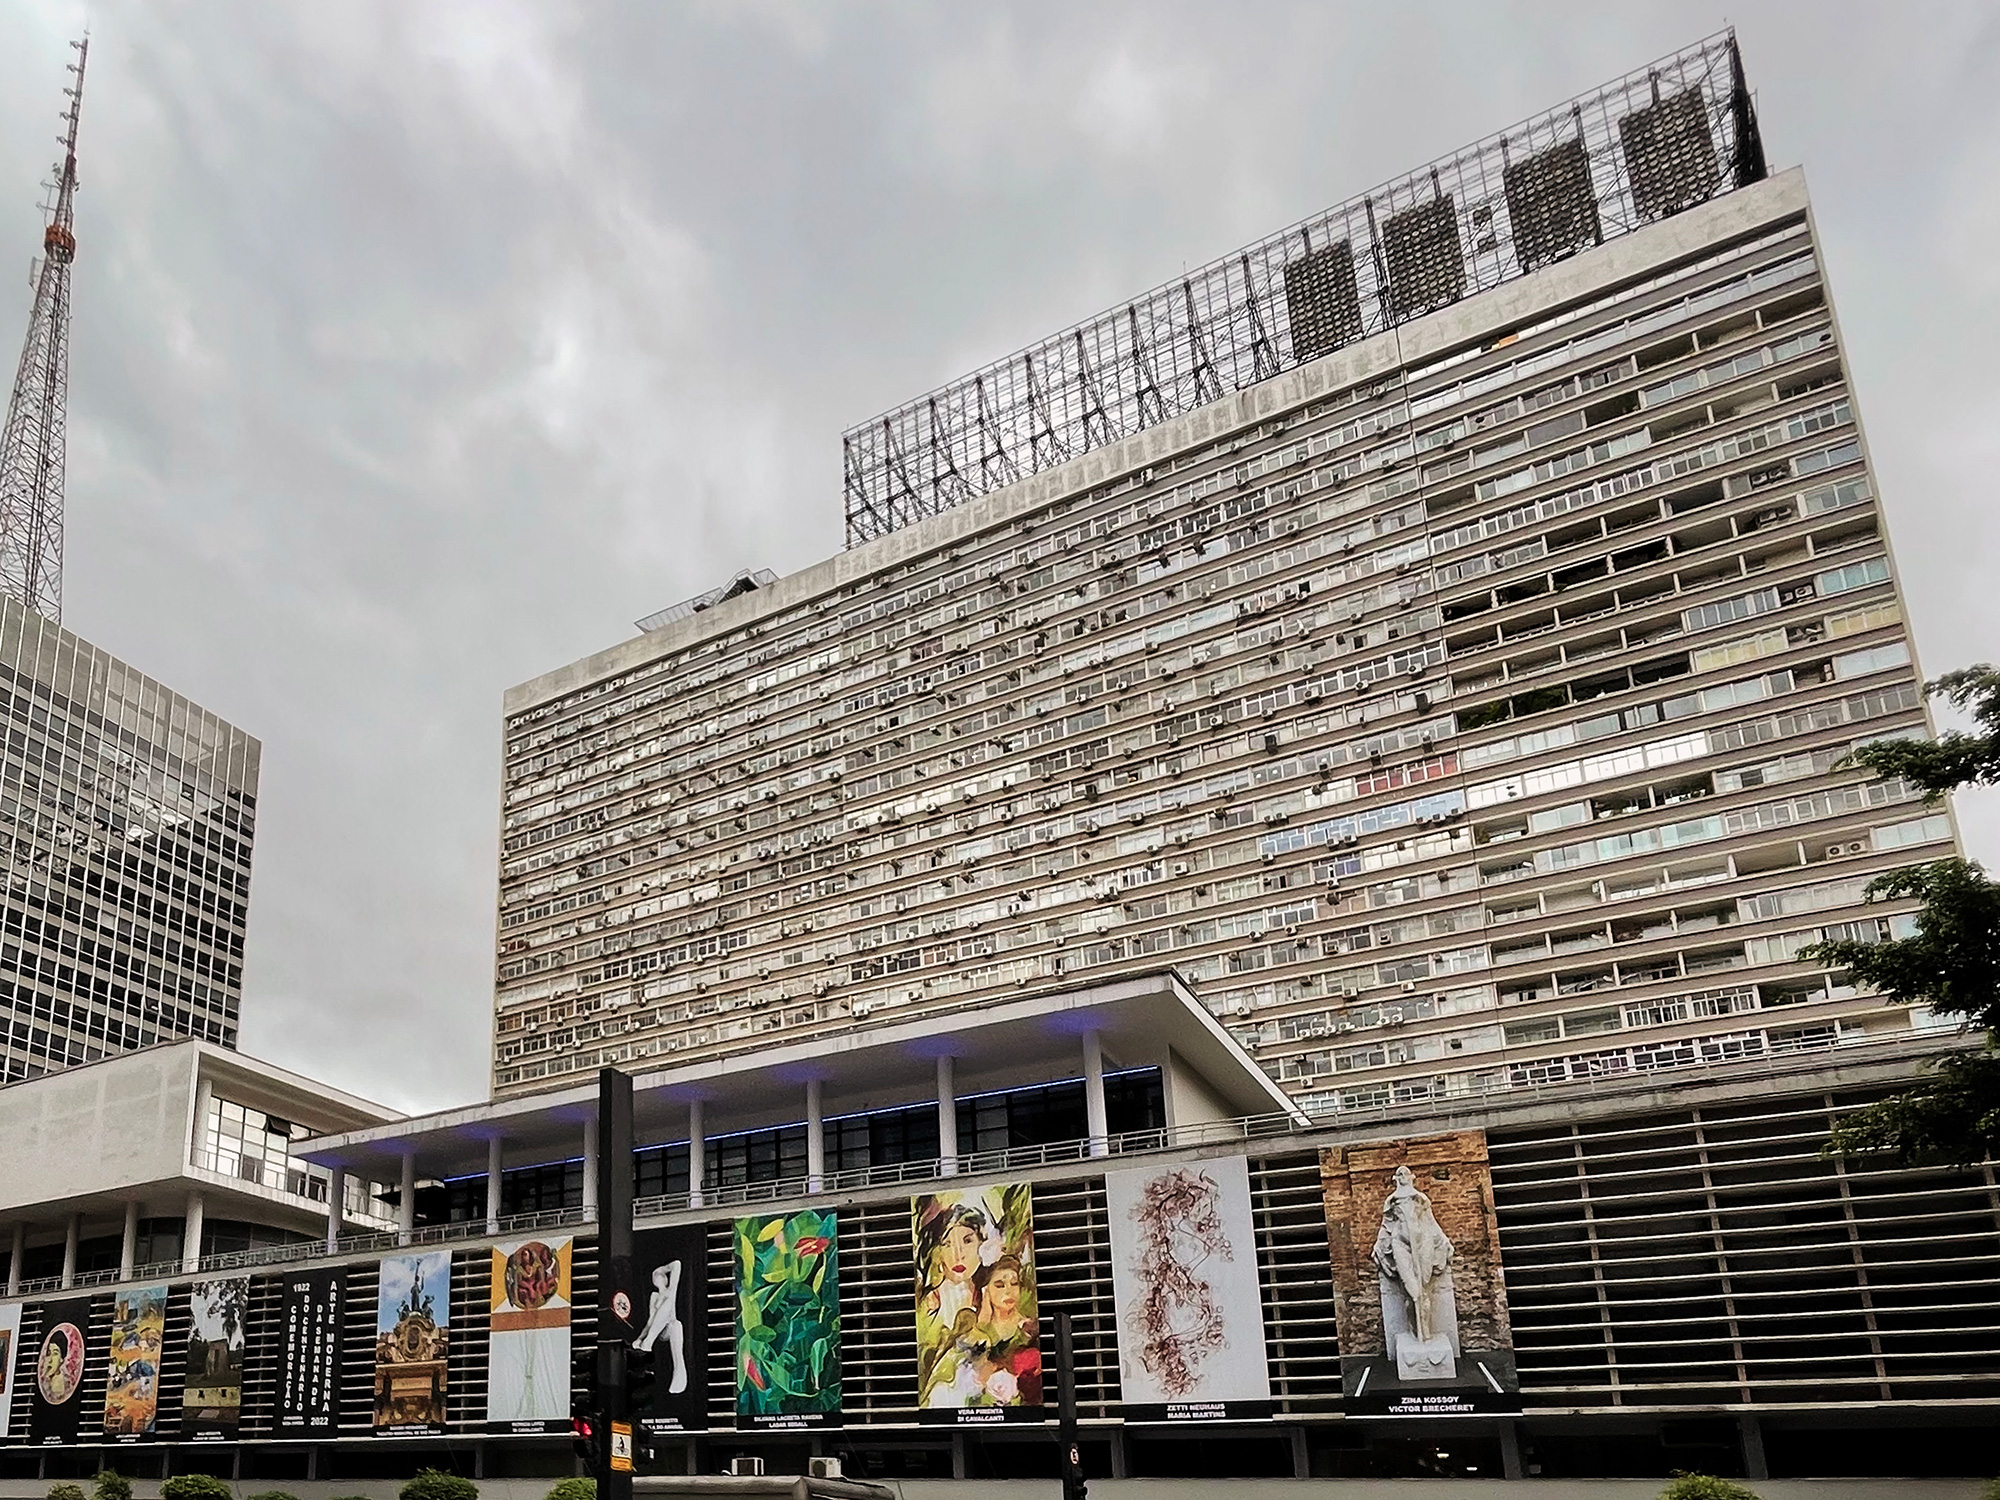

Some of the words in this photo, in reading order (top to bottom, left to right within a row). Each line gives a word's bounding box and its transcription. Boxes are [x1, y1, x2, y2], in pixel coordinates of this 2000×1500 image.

[303, 1295, 310, 1313] DO
[328, 1280, 338, 1324] ARTE
[316, 1304, 323, 1323] DA
[312, 1326, 321, 1383] SEMANA
[322, 1333, 335, 1412] MODERNA
[311, 1387, 318, 1406] DE
[310, 1416, 329, 1426] 2022
